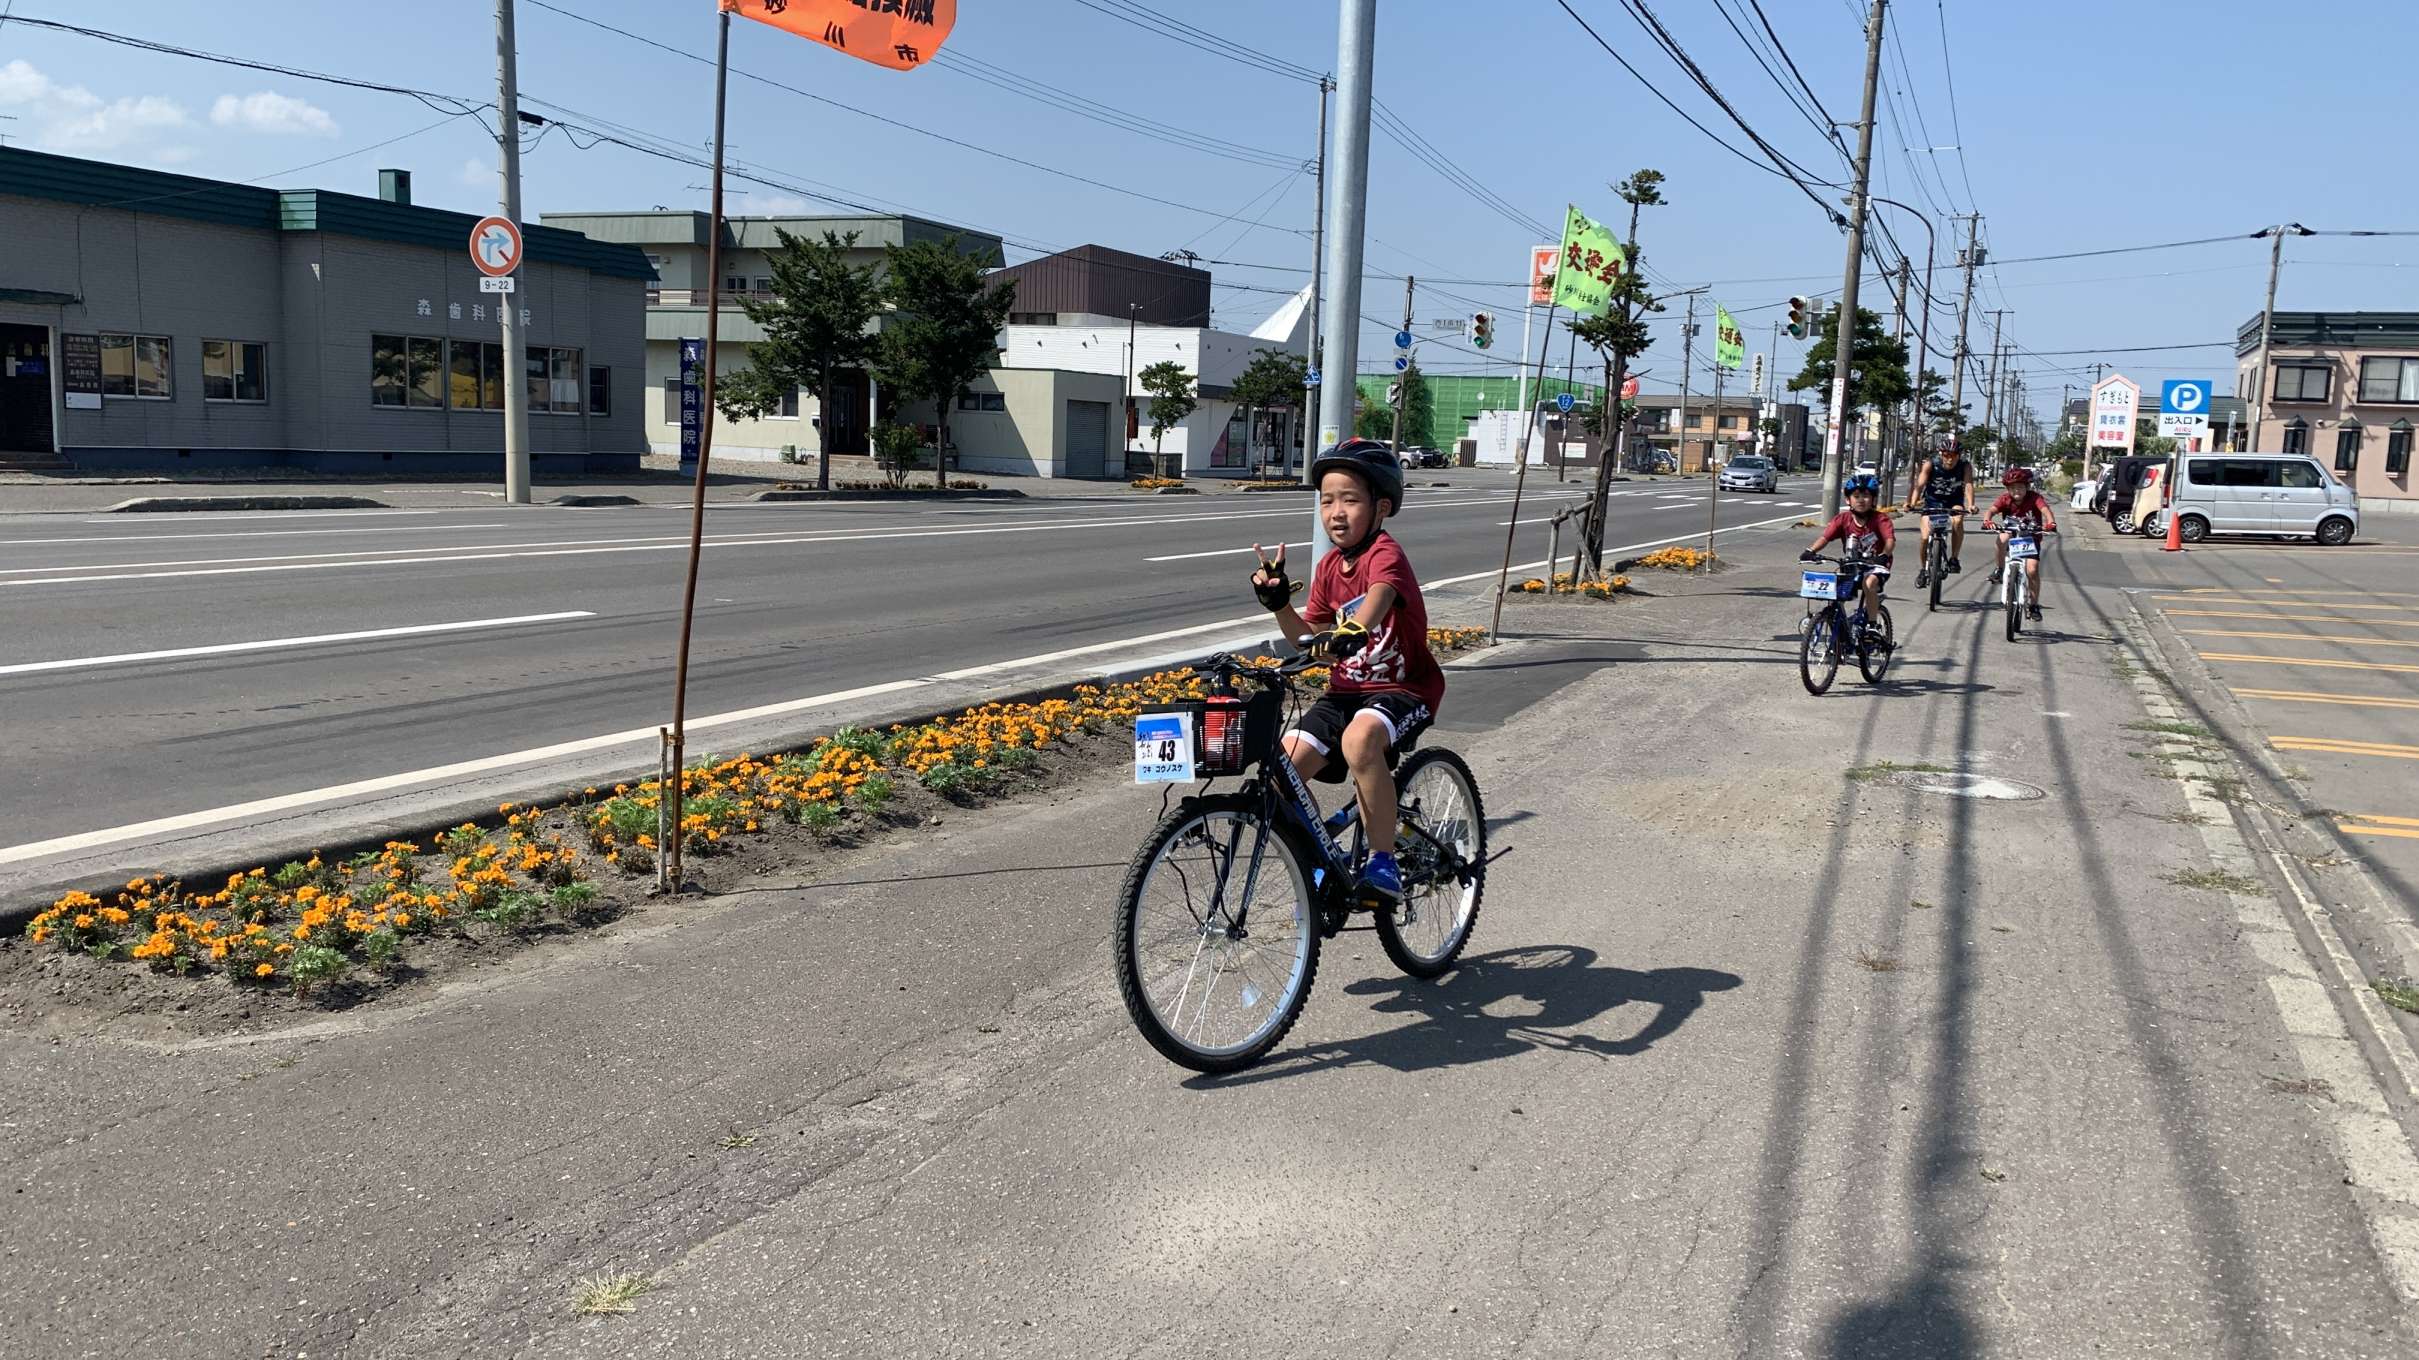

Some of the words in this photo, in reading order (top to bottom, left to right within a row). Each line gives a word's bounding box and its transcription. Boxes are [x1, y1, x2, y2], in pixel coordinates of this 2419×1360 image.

[484, 280, 509, 290] 9-22
[2164, 416, 2193, 425] 出入口
[1158, 740, 1176, 762] 43
[1312, 816, 1339, 860] EAGLE
